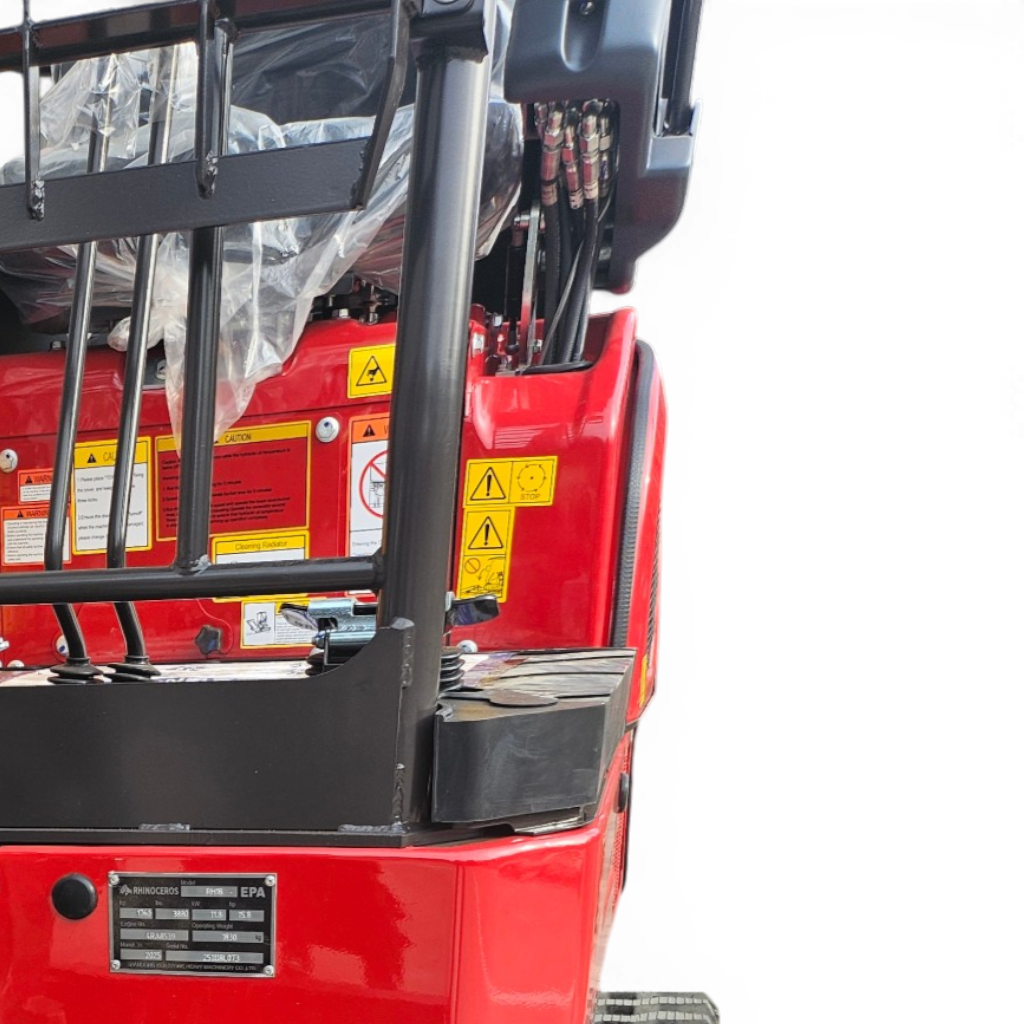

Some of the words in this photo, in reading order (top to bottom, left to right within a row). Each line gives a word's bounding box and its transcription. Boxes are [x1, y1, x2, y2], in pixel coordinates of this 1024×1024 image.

[225, 432, 252, 443] CAUTION
[34, 474, 52, 483] WARN
[519, 493, 541, 501] STOP
[235, 543, 261, 551] Cleaning
[262, 540, 288, 549] Radiator
[132, 886, 179, 896] RHINOCEROS
[240, 886, 266, 898] EPA
[191, 922, 216, 930] Operating
